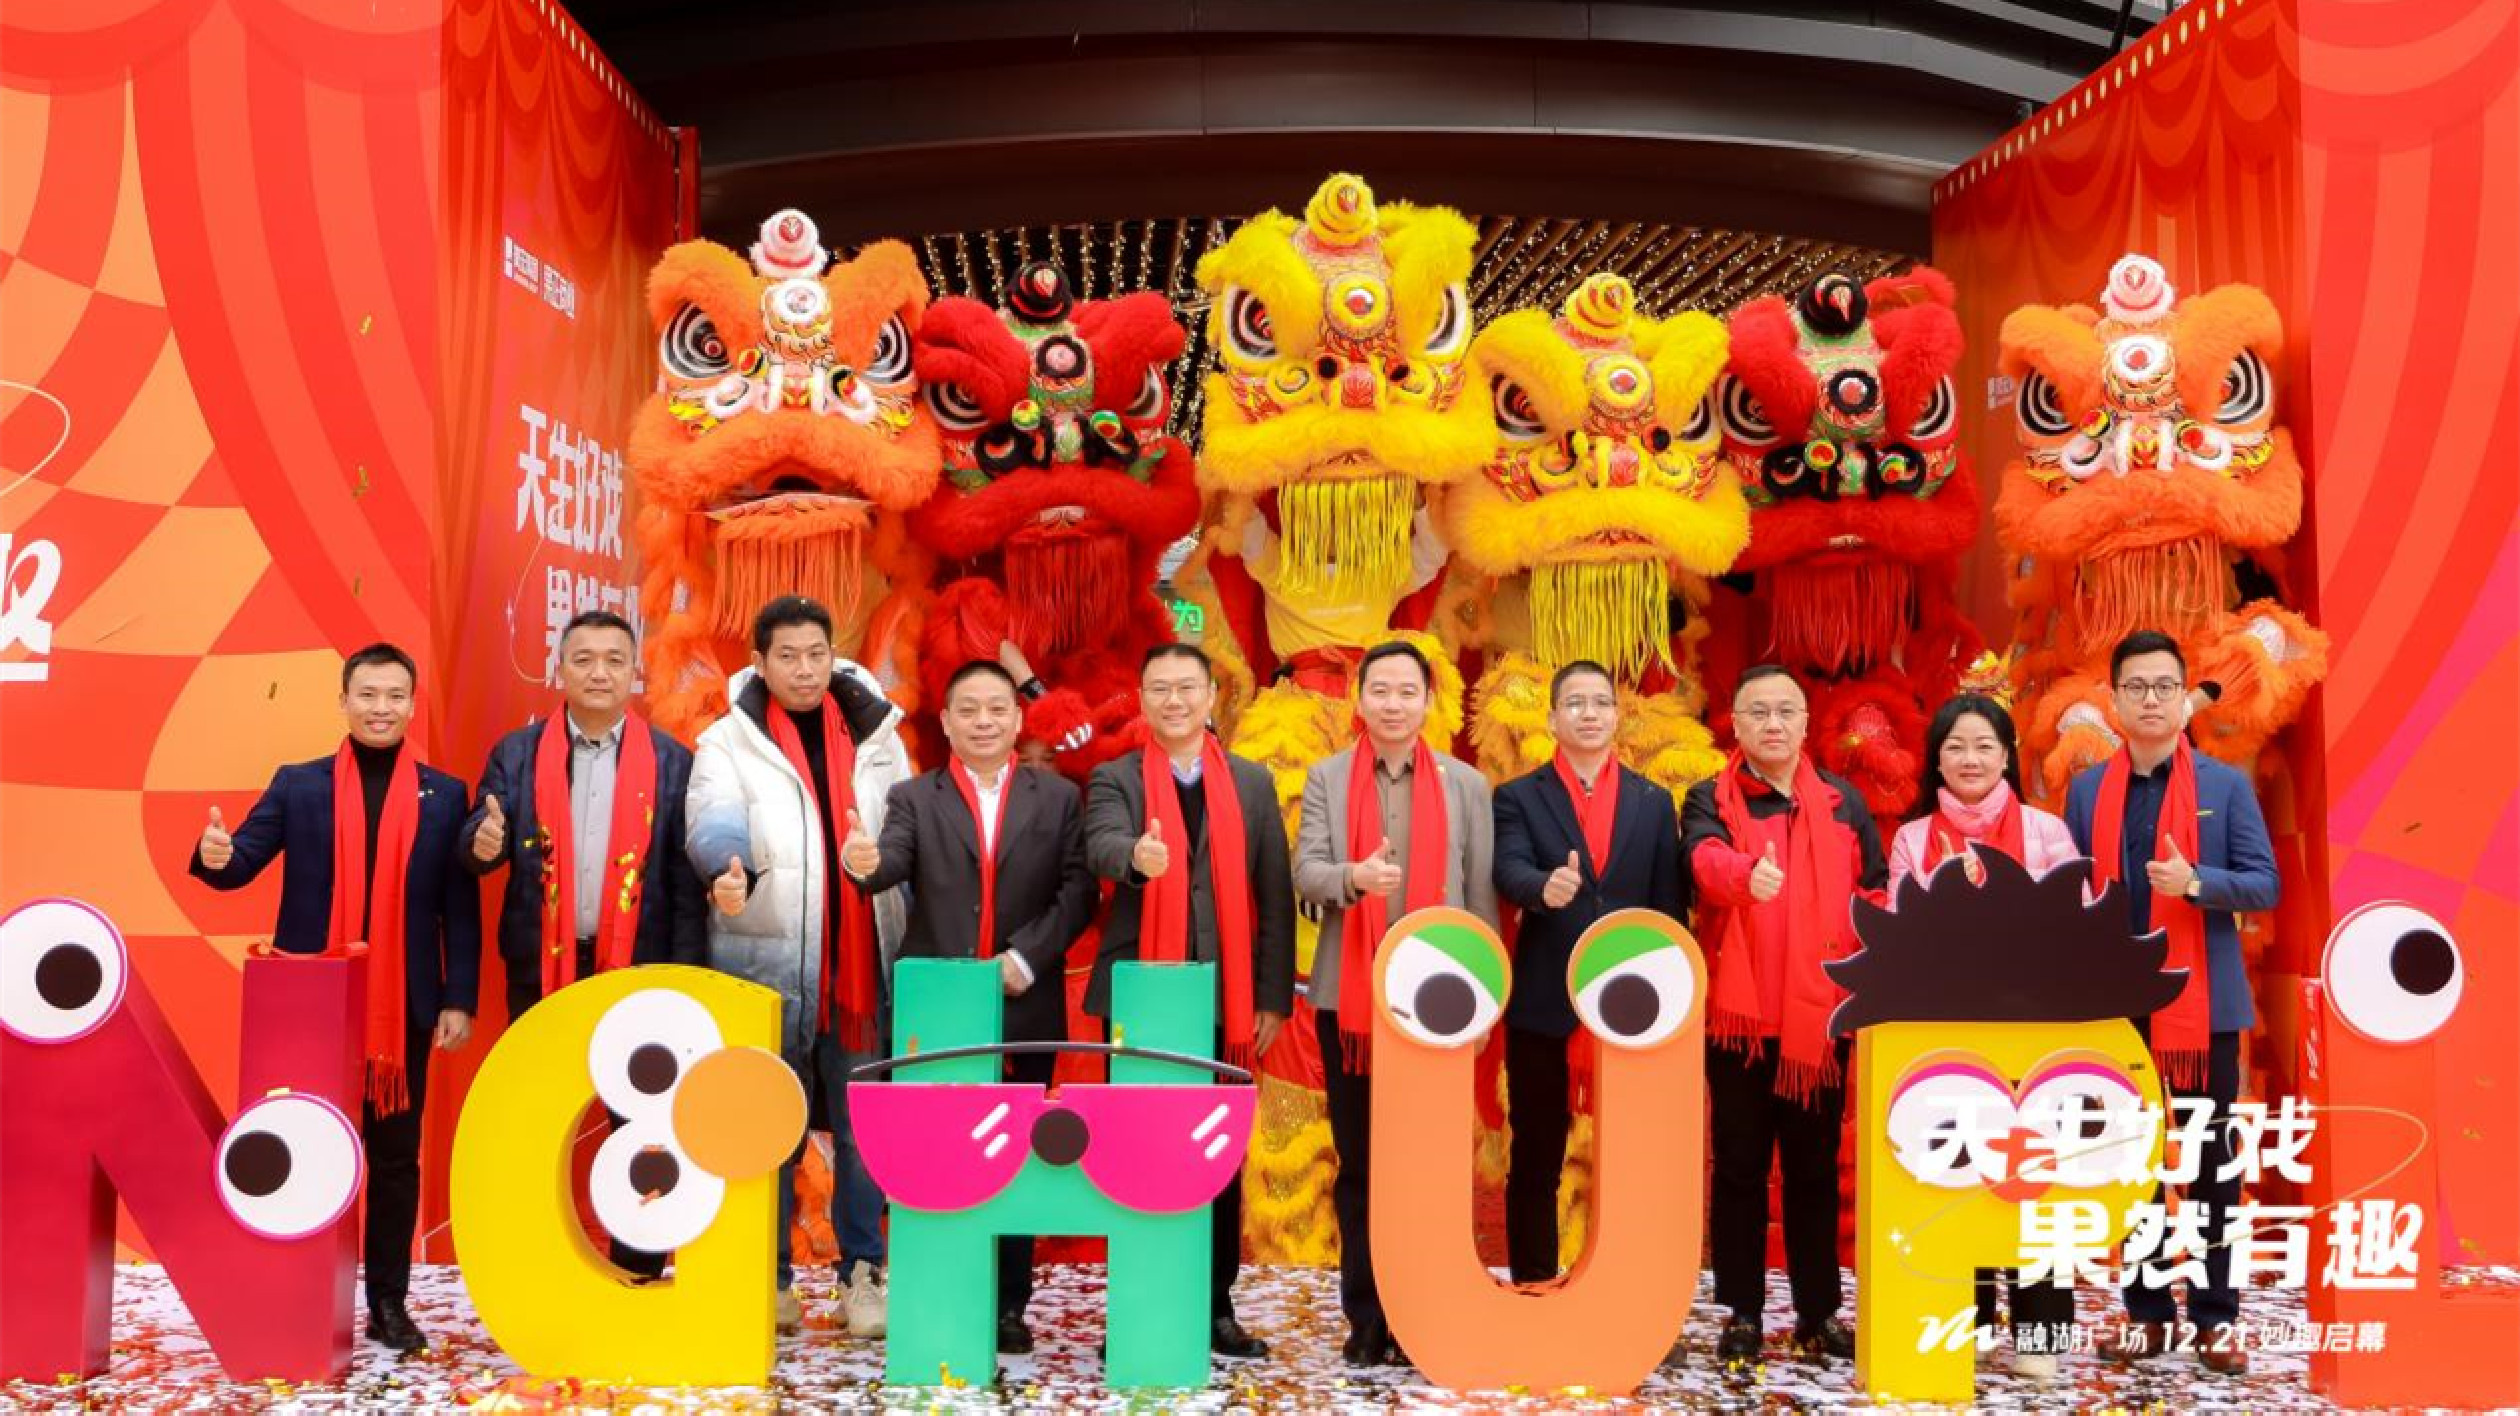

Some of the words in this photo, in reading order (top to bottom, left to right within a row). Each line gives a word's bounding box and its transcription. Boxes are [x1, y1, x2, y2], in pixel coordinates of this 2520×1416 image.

[517, 404, 622, 560] 天生好戏
[1172, 599, 1205, 632] 为
